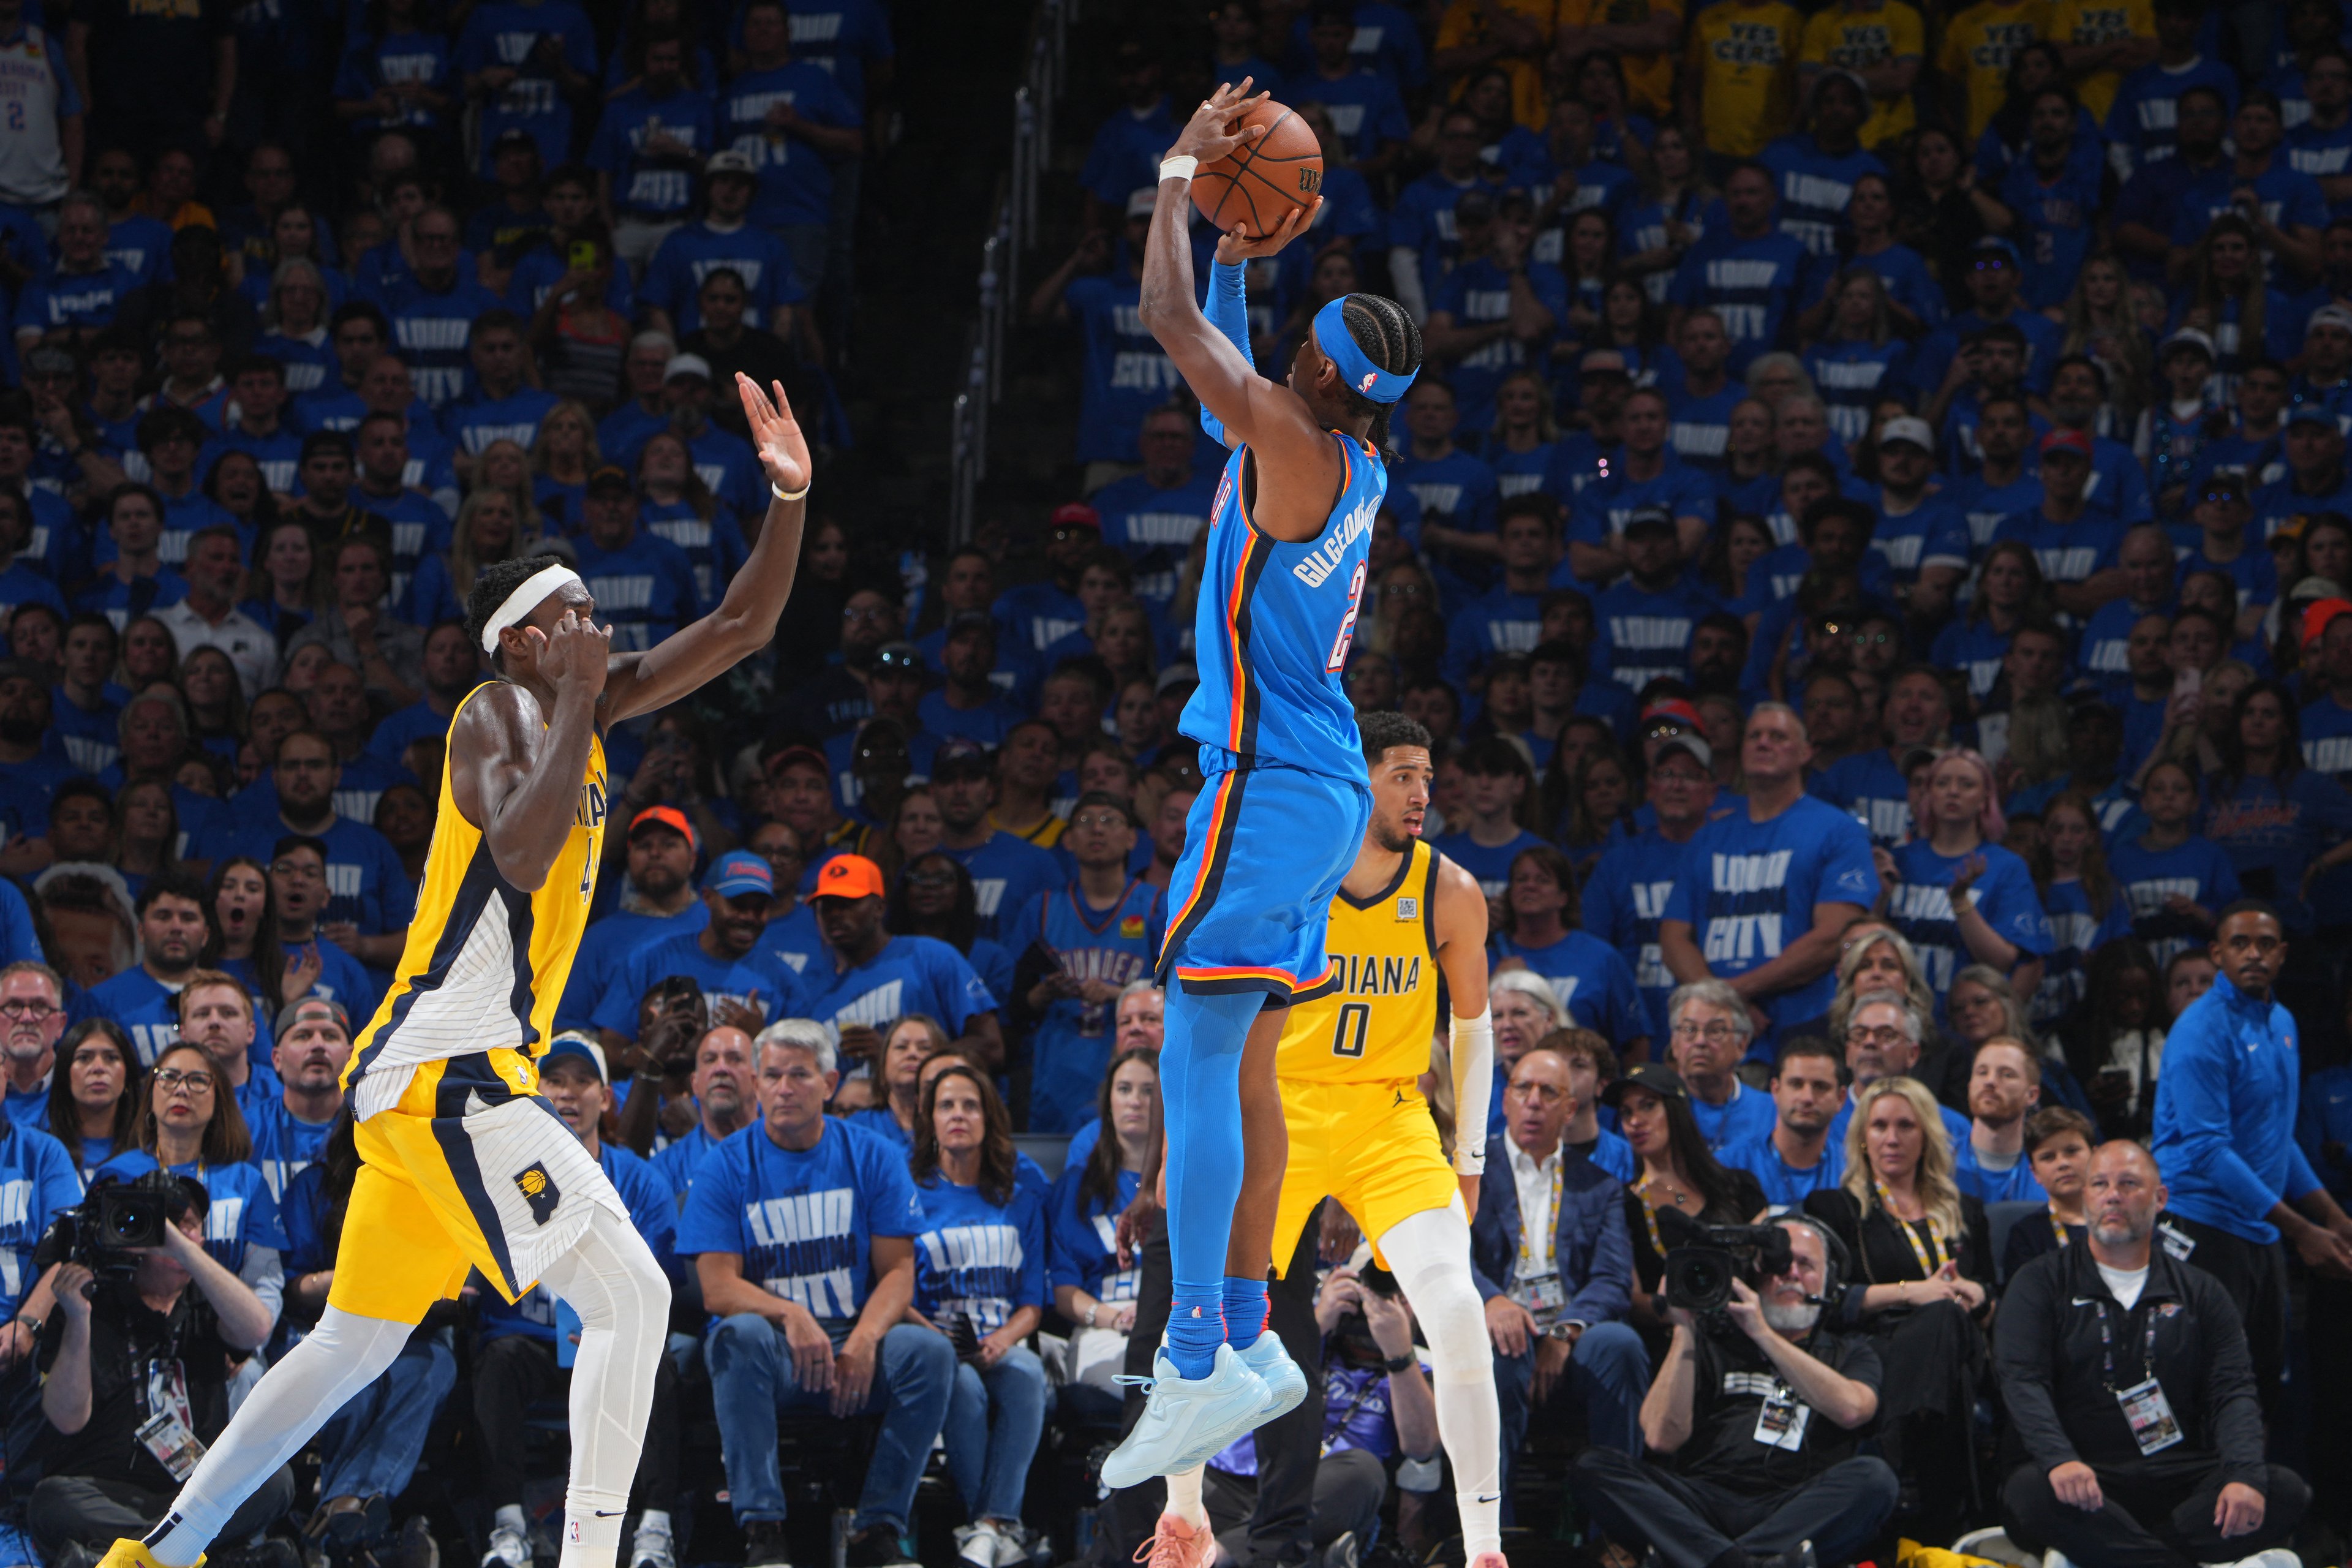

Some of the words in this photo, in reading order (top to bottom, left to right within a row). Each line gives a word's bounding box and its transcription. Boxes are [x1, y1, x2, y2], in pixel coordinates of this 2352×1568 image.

[1325, 559, 1367, 674] 2
[1326, 953, 1422, 996] DIANA
[1332, 1000, 1372, 1060] 0
[745, 1187, 854, 1248] LOUD
